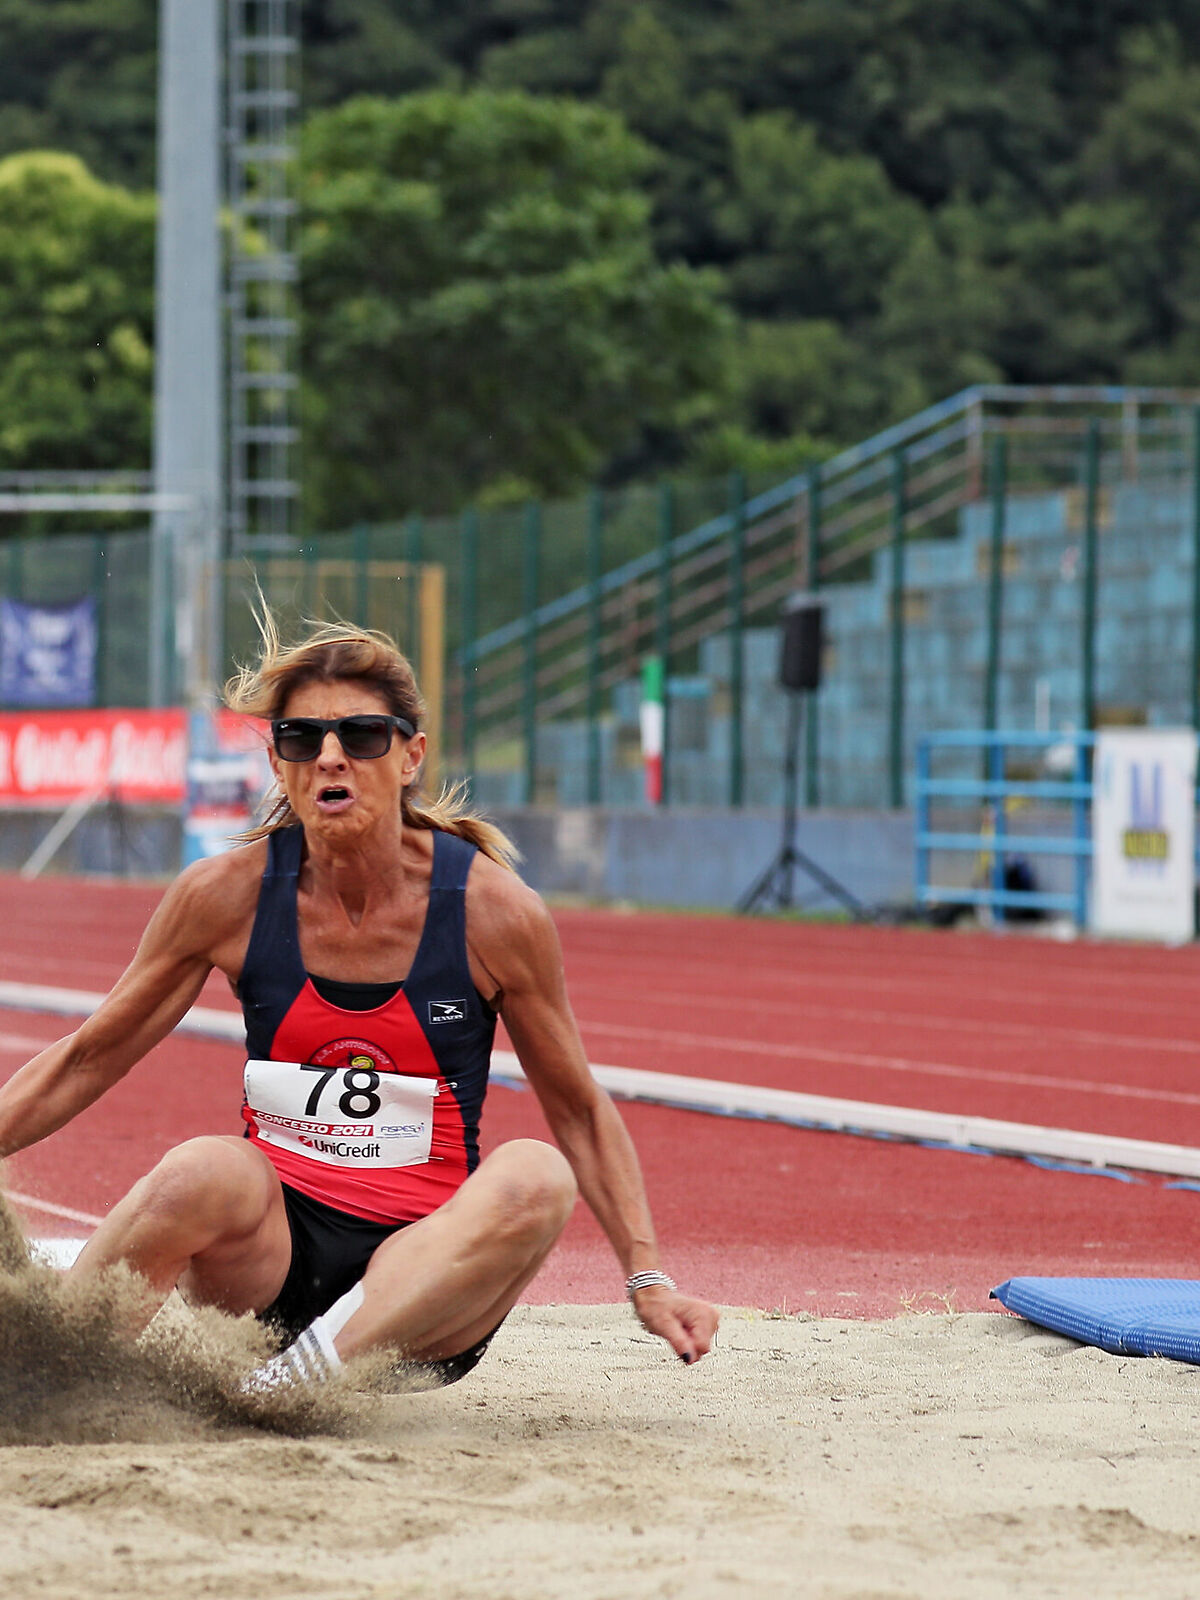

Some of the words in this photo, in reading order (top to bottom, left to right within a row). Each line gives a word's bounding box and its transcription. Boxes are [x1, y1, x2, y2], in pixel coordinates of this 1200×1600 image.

[300, 1064, 382, 1119] 78
[255, 1111, 329, 1137] CONCESIO
[330, 1124, 372, 1137] 2021
[313, 1139, 381, 1159] UniCredit
